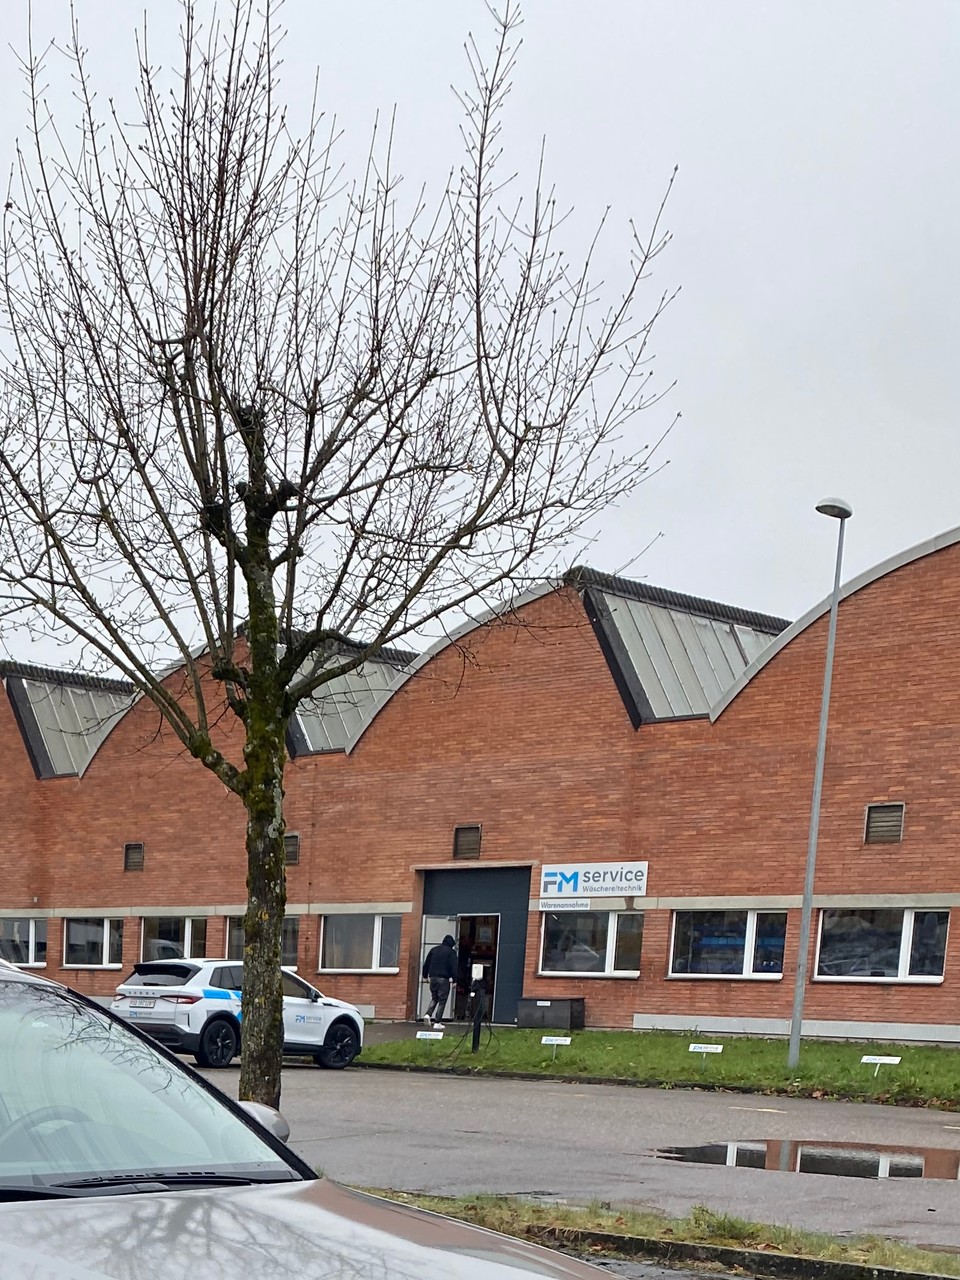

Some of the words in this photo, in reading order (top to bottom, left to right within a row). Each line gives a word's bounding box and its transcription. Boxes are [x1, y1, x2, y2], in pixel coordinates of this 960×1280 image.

[543, 871, 579, 893] FM
[582, 867, 644, 883] service
[540, 900, 589, 909] Warenannahme
